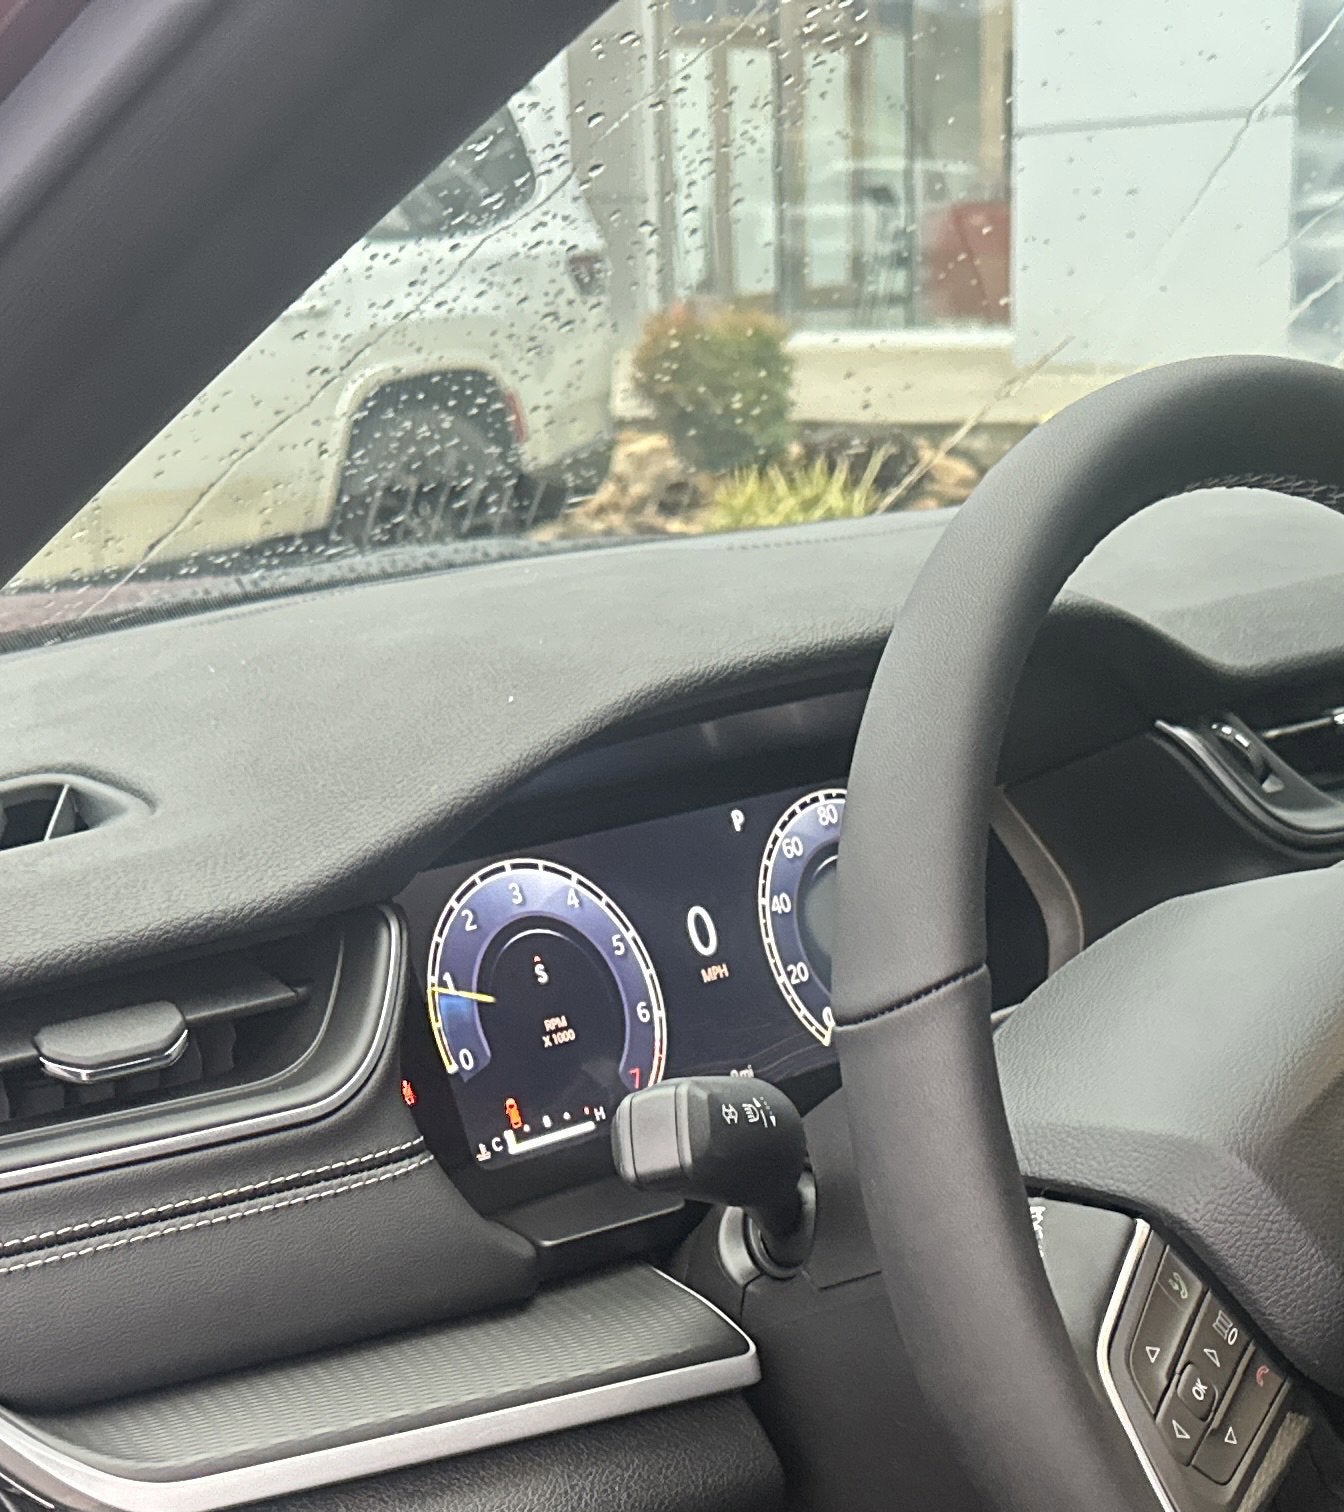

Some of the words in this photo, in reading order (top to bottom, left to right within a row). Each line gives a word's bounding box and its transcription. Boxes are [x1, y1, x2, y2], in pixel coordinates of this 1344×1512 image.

[730, 809, 745, 832] P
[817, 804, 838, 826] 80
[782, 836, 804, 859] 60
[508, 882, 523, 905] 3
[566, 887, 580, 909] 4
[771, 892, 792, 914] 40
[461, 909, 478, 932] 2
[687, 905, 718, 957] 0
[611, 934, 626, 956] 5
[442, 972, 456, 991] 1
[534, 964, 549, 985] S
[700, 963, 730, 983] MPH
[786, 961, 809, 985] 20
[636, 1001, 651, 1023] 6
[822, 1006, 836, 1028] 0
[543, 1015, 568, 1032] RPM
[552, 1028, 576, 1045] 1000
[459, 1048, 475, 1071] 0
[628, 1067, 641, 1089] 7
[593, 1106, 606, 1122] H
[491, 1137, 504, 1152] C
[1192, 1377, 1208, 1401] OK
